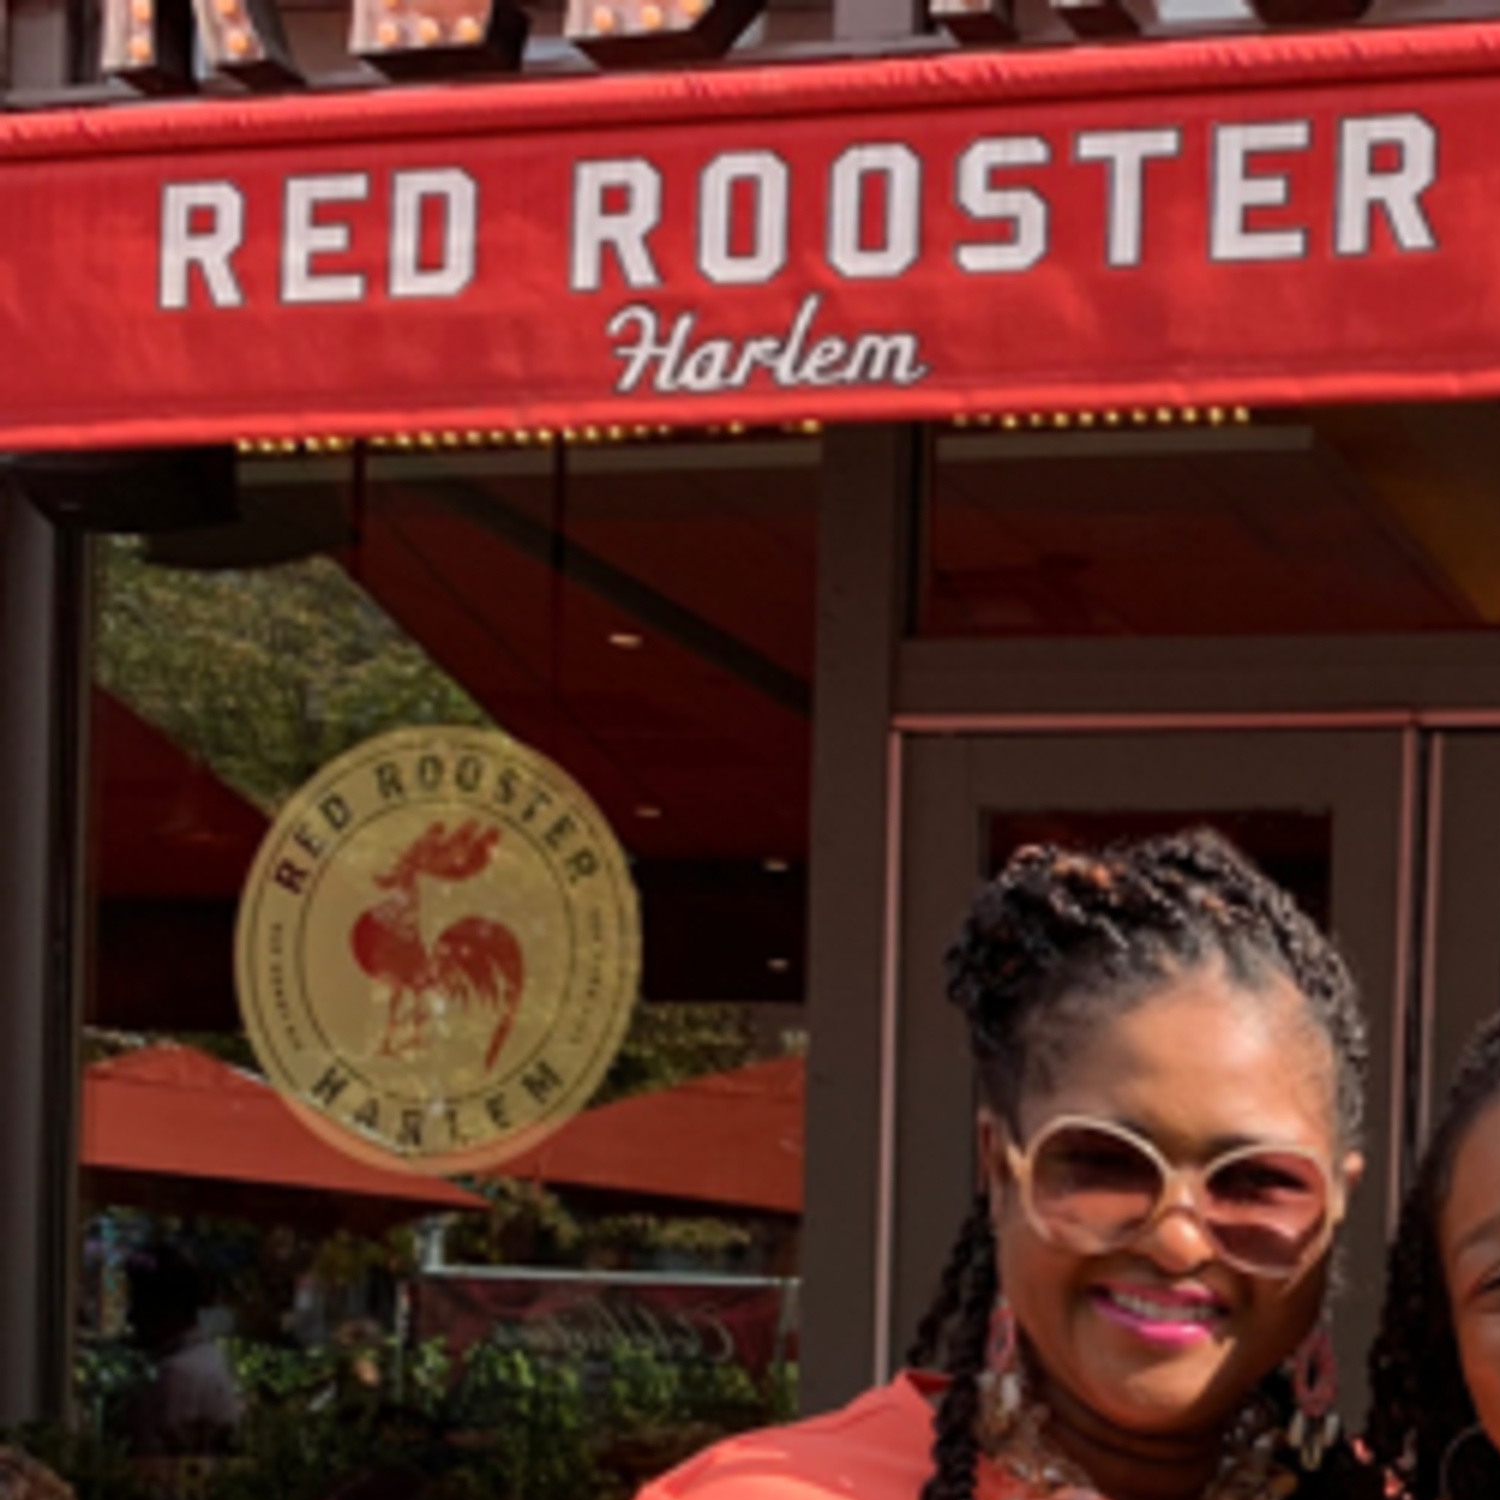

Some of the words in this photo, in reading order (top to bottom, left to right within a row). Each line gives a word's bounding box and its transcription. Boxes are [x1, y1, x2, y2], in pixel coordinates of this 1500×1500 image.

[158, 167, 479, 310] RED
[569, 112, 1439, 292] ROOSTER
[606, 293, 928, 393] Harlem
[273, 794, 353, 896] RED
[374, 755, 600, 886] ROOSTER
[310, 1060, 564, 1148] HARLEM
